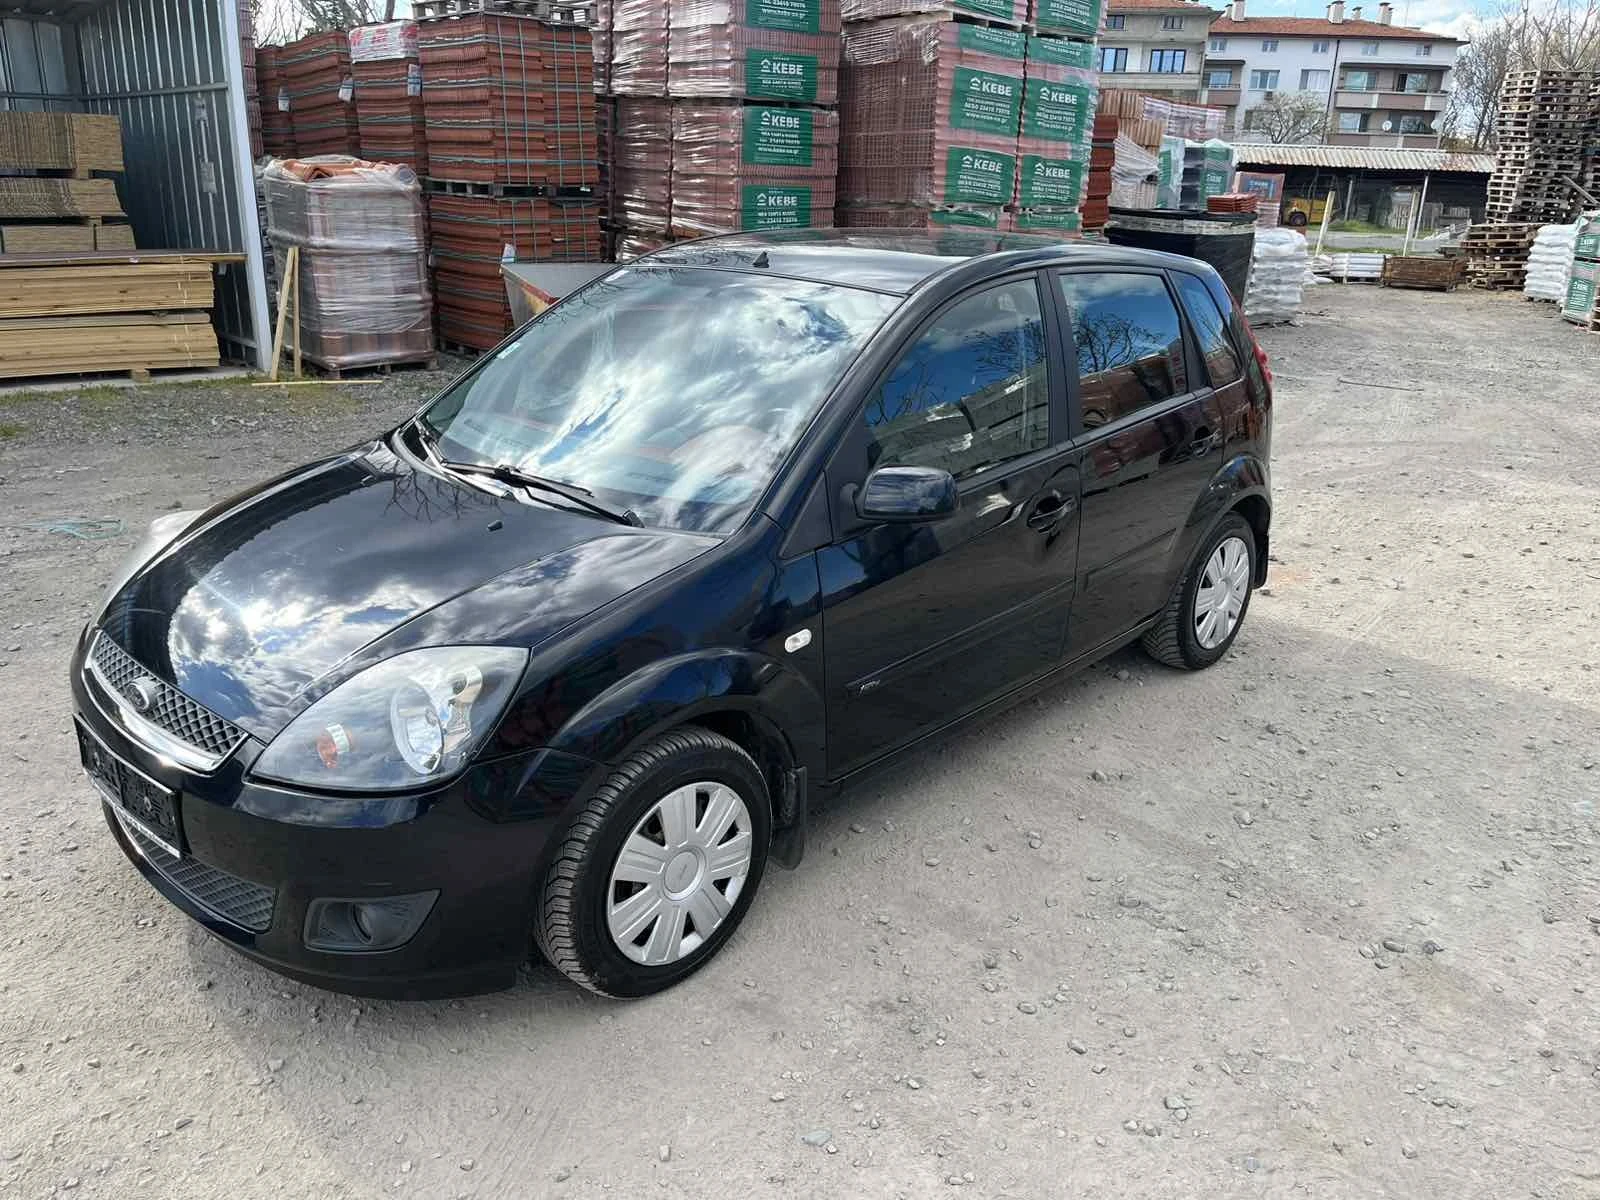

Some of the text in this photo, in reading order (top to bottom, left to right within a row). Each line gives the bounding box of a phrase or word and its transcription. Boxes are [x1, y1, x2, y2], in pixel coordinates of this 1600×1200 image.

[772, 62, 804, 75] KEBE
[982, 81, 1013, 96] KEBE
[1051, 91, 1077, 104] KEBE
[771, 115, 800, 128] KEBE
[974, 159, 1002, 173] KEBE
[1045, 167, 1070, 178] KEBE
[768, 196, 798, 206] KEBE
